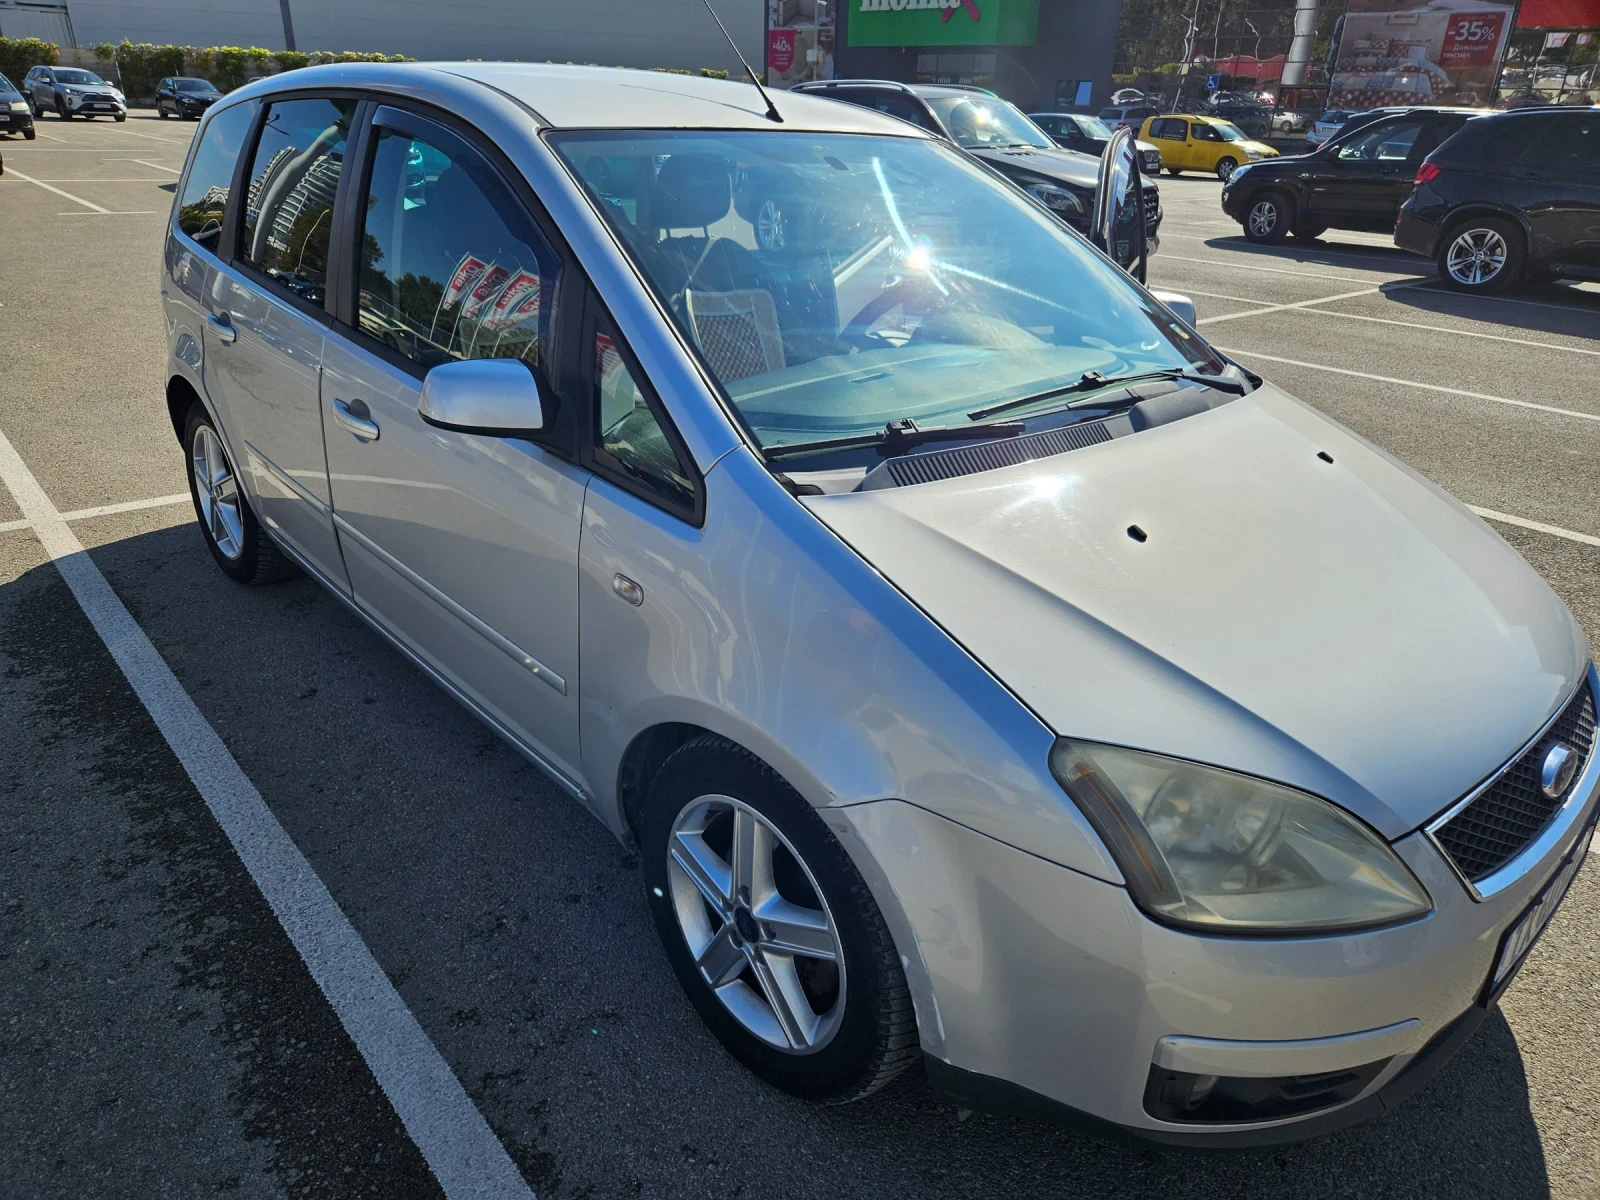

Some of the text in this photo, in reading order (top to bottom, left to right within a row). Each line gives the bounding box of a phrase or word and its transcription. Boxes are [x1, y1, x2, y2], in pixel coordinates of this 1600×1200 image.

[1448, 21, 1495, 41] -35%
[455, 264, 478, 288] aiko
[501, 281, 528, 305] aiko
